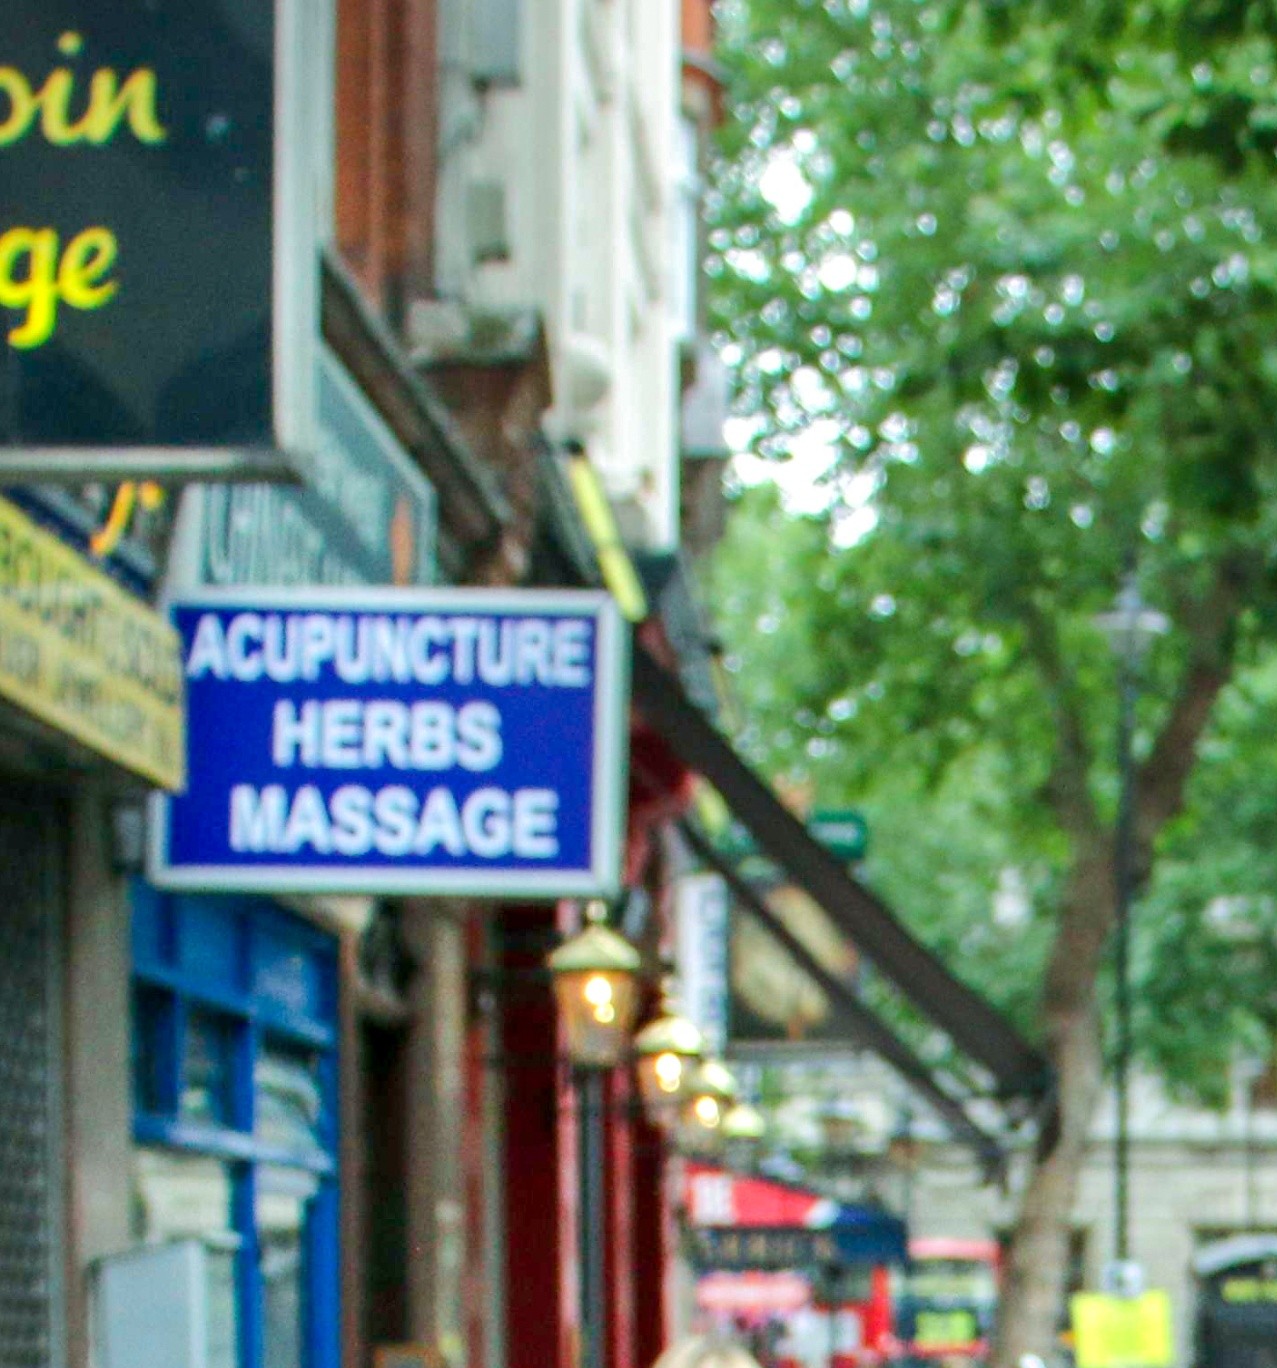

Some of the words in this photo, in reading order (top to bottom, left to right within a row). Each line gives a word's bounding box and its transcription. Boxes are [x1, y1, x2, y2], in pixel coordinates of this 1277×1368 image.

[188, 613, 589, 687] ACUPUNCTURE
[272, 699, 502, 768] HERBS
[230, 785, 559, 856] MASSAGE
